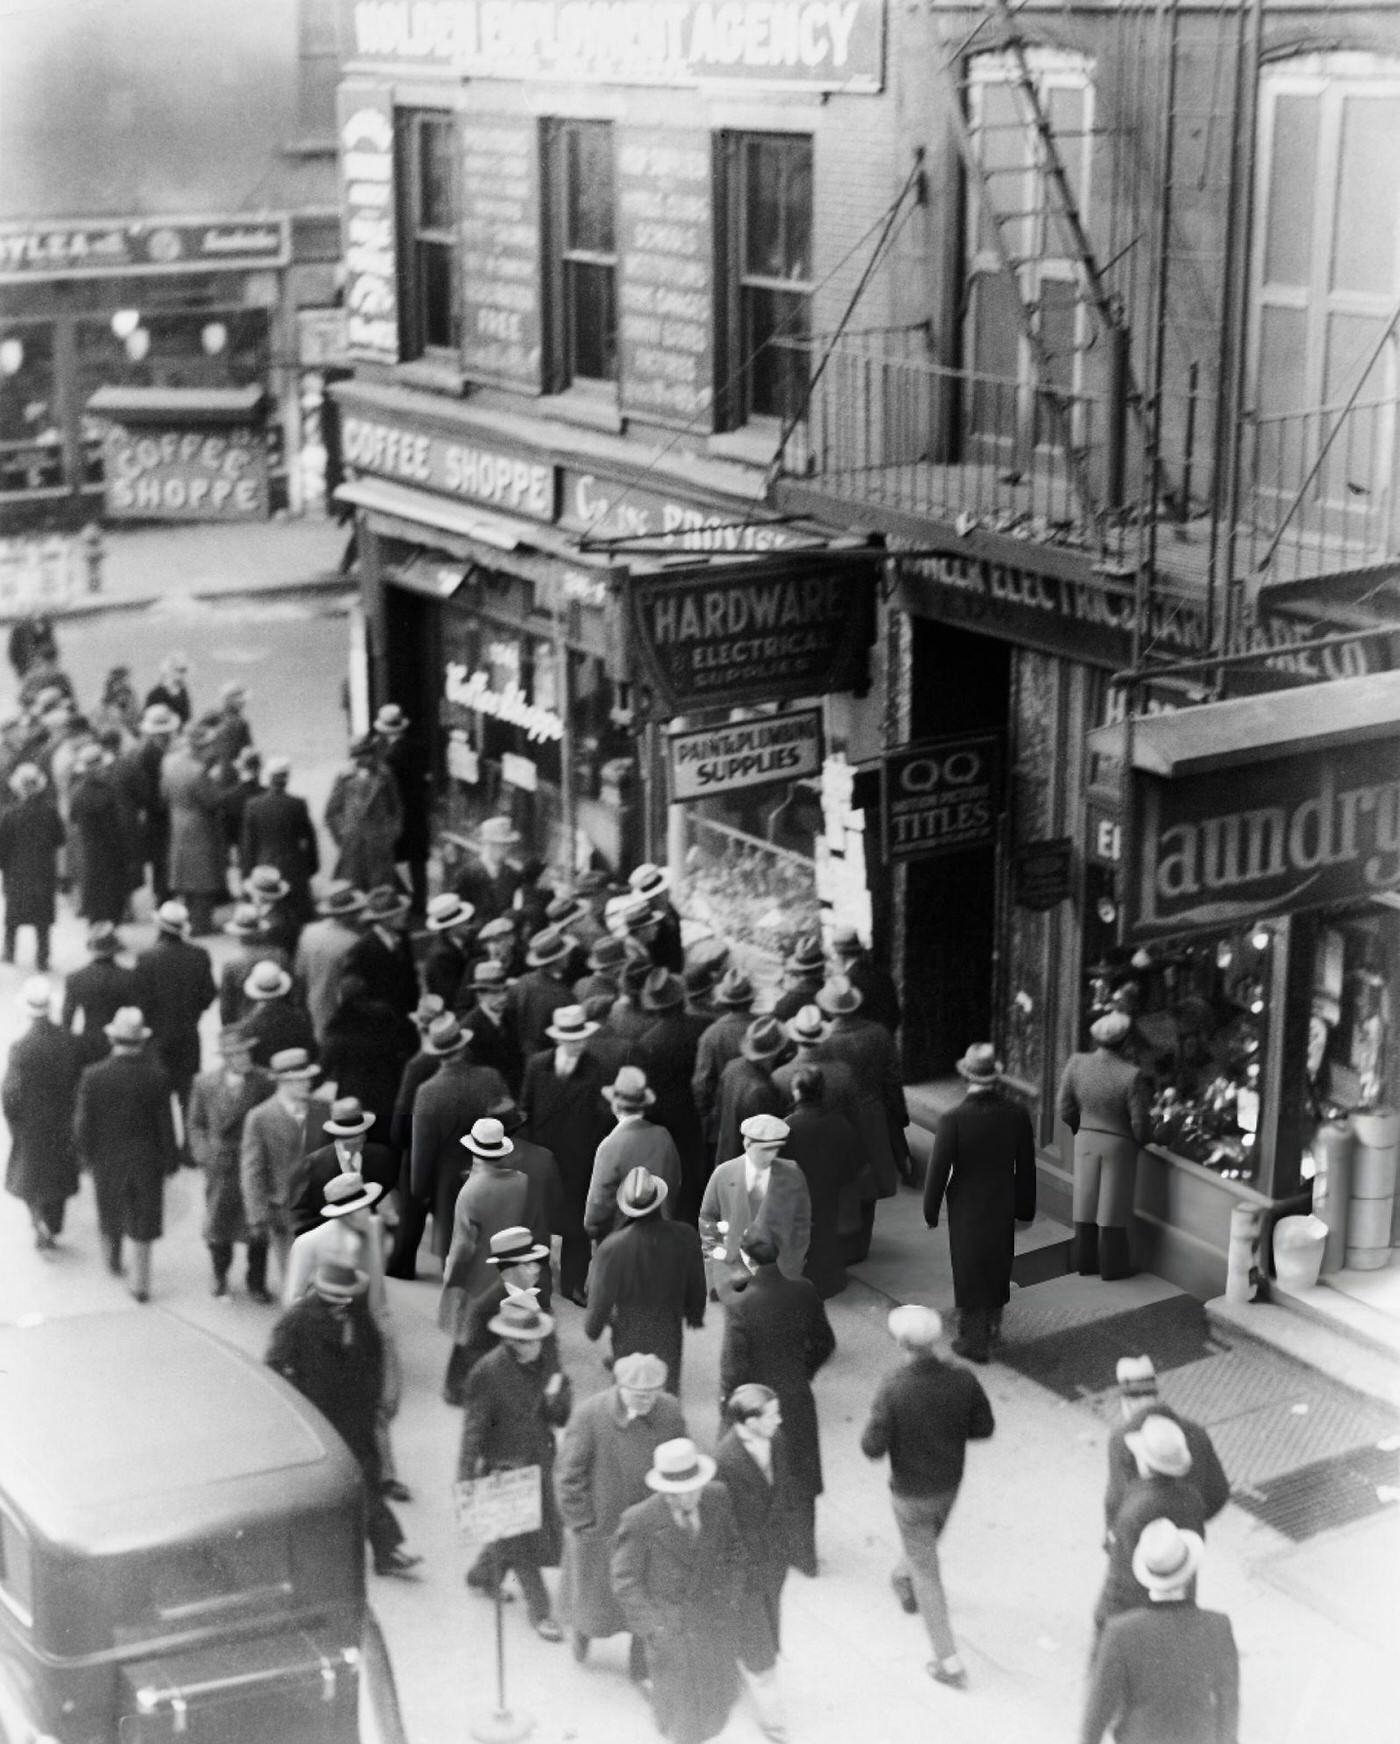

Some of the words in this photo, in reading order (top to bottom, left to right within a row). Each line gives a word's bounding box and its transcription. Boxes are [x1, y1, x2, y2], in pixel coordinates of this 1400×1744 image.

[483, 4, 688, 63] EMPLOYMENT
[690, 3, 858, 64] AGENCY
[116, 434, 249, 478] COFFEE
[342, 416, 430, 480] COFFEE
[446, 444, 549, 513] SHOPPE
[107, 477, 260, 510] SHOPPE
[654, 577, 844, 645] HARDWARE
[697, 746, 801, 786] SUPPLIES
[891, 801, 990, 842] TITLES
